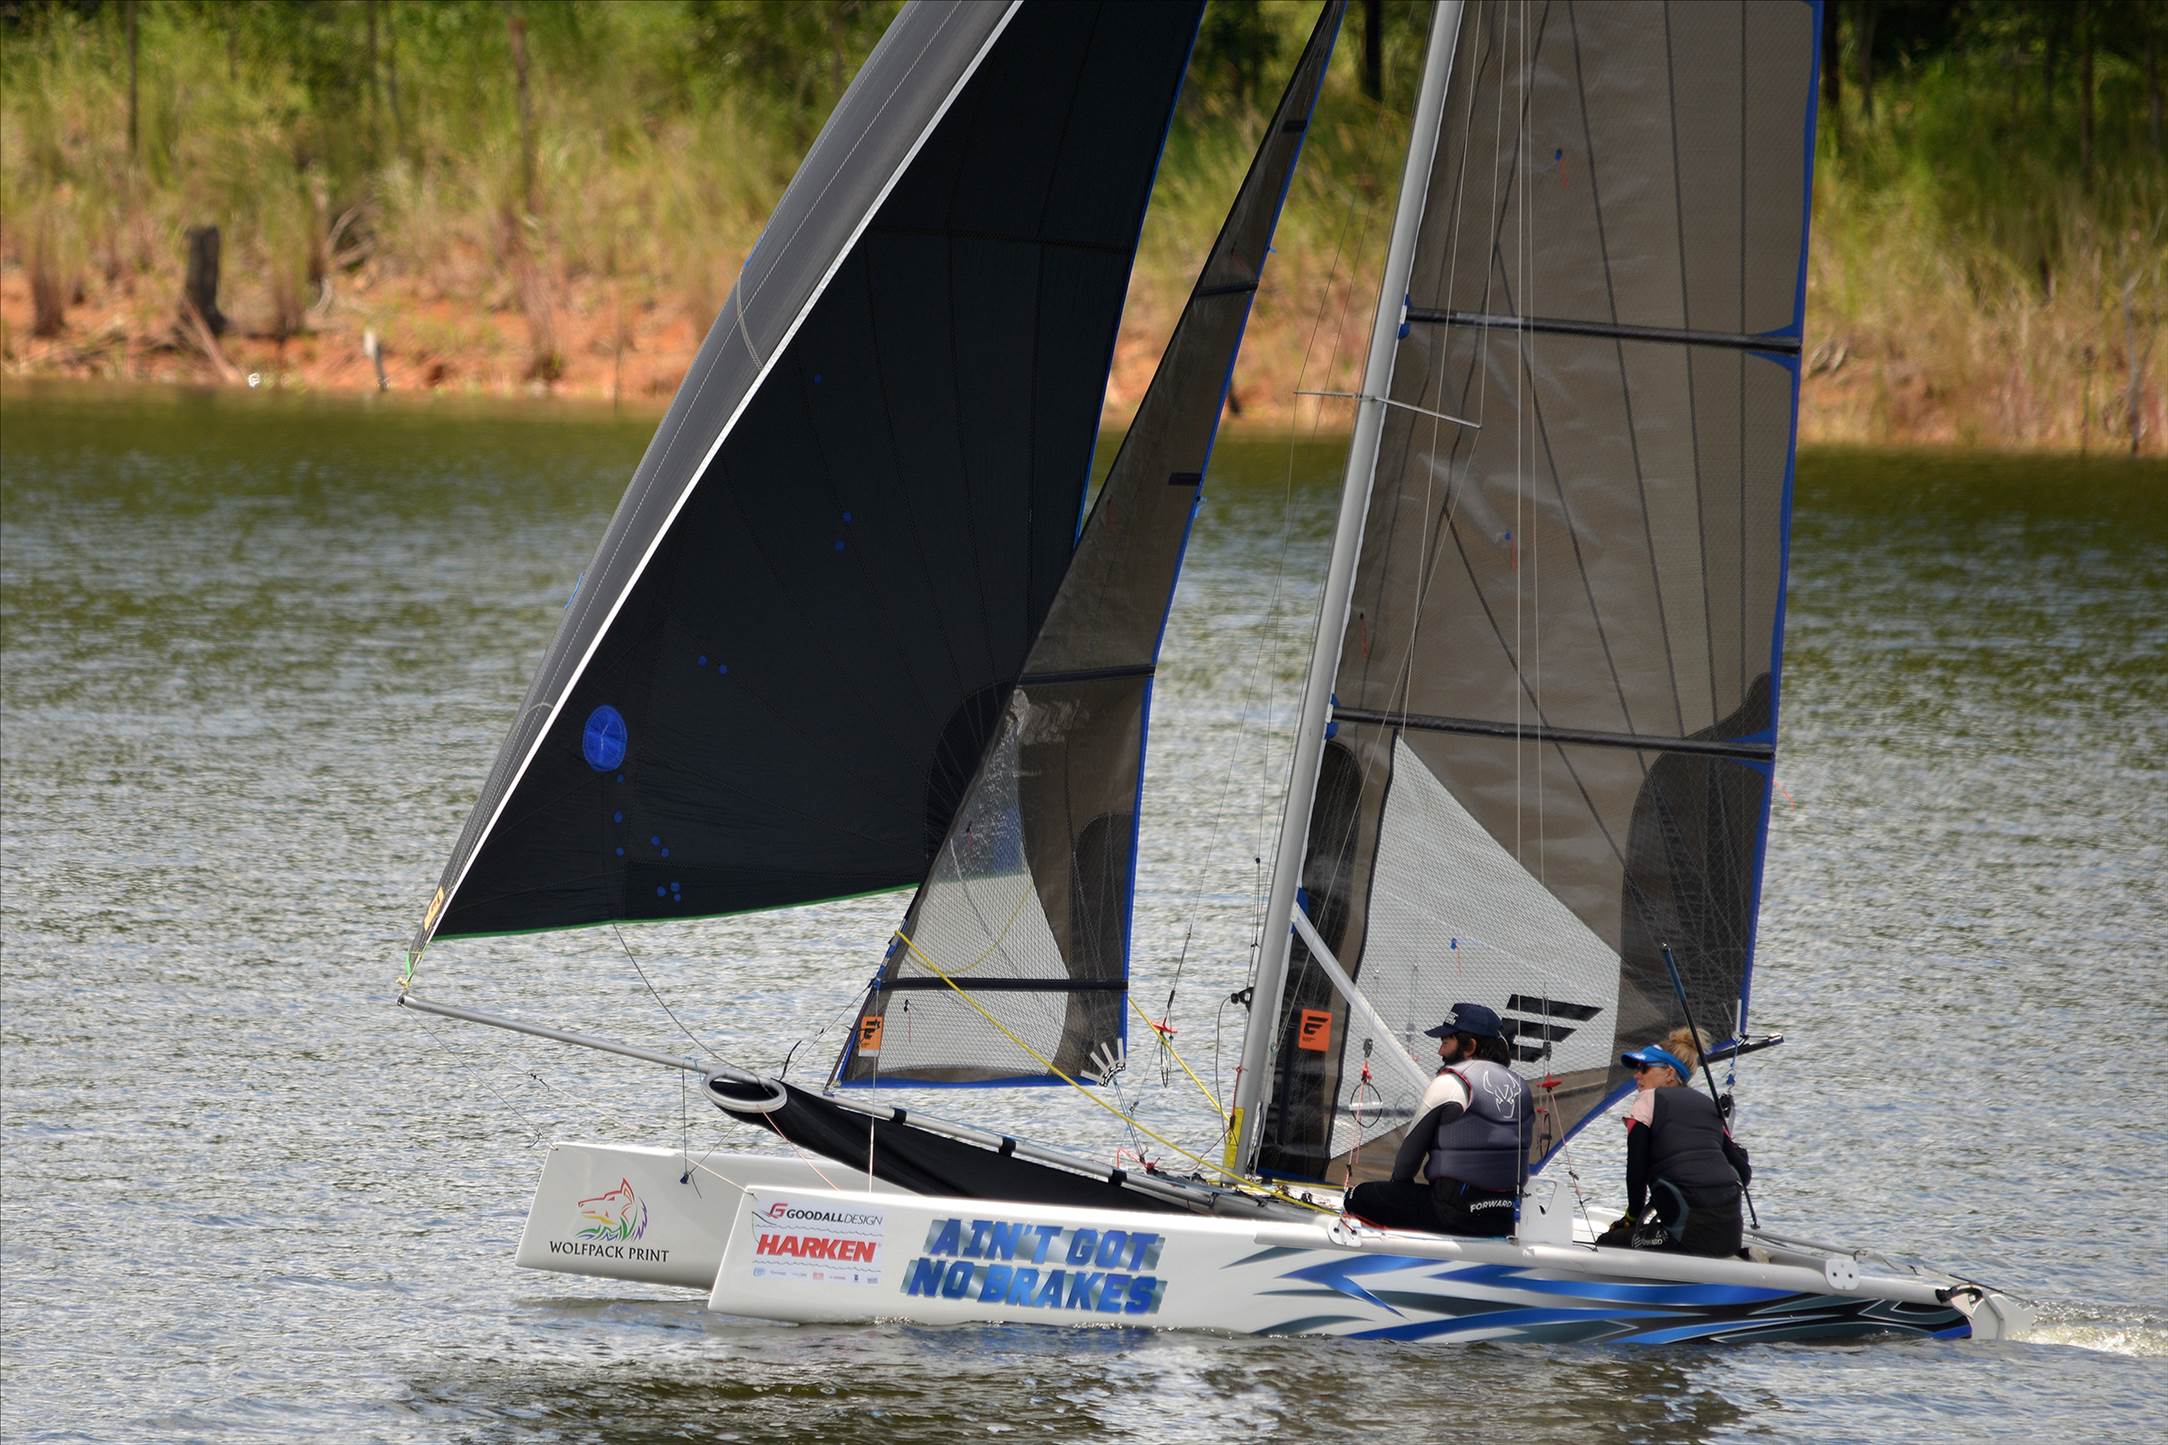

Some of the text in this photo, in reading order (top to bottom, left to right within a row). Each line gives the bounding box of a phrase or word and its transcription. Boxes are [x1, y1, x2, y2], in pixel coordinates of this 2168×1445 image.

[1469, 1200, 1513, 1213] FORWARD
[550, 1241, 669, 1263] WOLFPACK PRINT
[756, 1233, 877, 1263] HARKEN
[928, 1218, 1160, 1272] AIN'T GOT
[907, 1257, 1158, 1315] NO BRAKES
